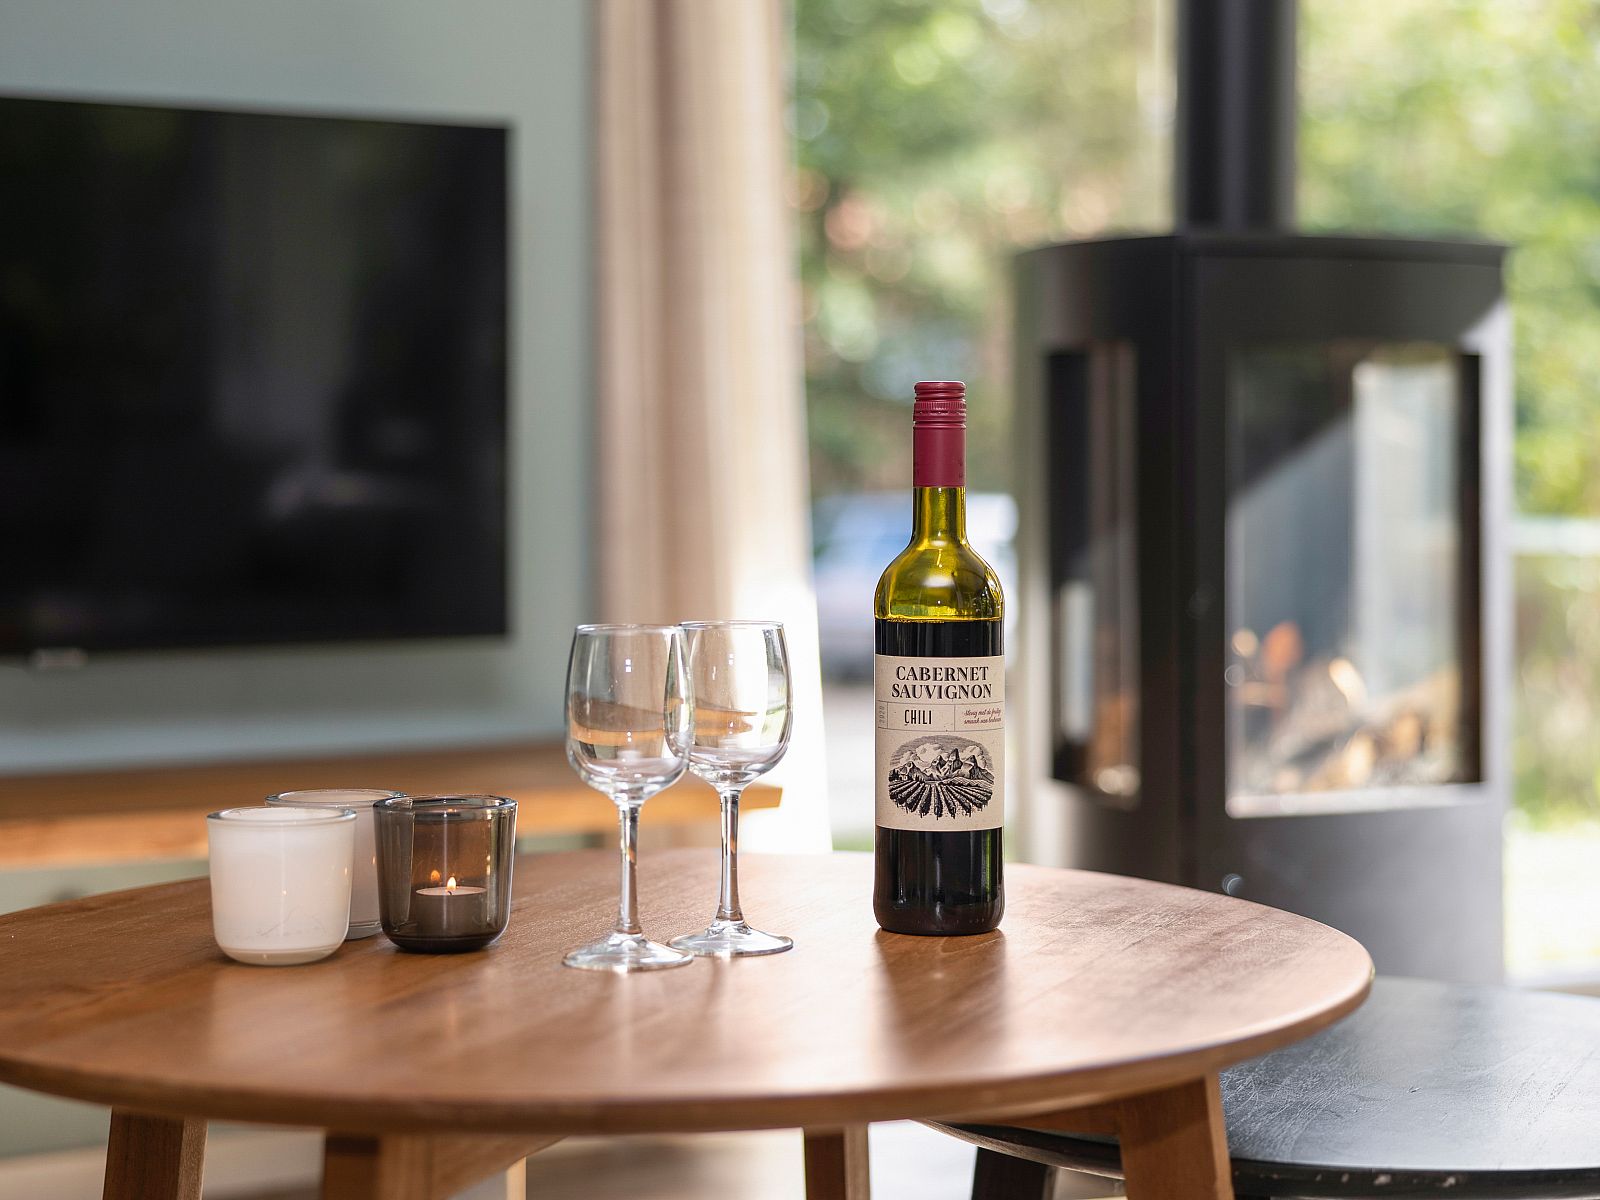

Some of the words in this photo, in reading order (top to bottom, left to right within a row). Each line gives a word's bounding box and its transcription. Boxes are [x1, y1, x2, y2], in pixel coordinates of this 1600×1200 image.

[896, 665, 989, 682] CABERNET
[891, 683, 992, 700] SAUVIGNON
[904, 709, 932, 725] CHILI
